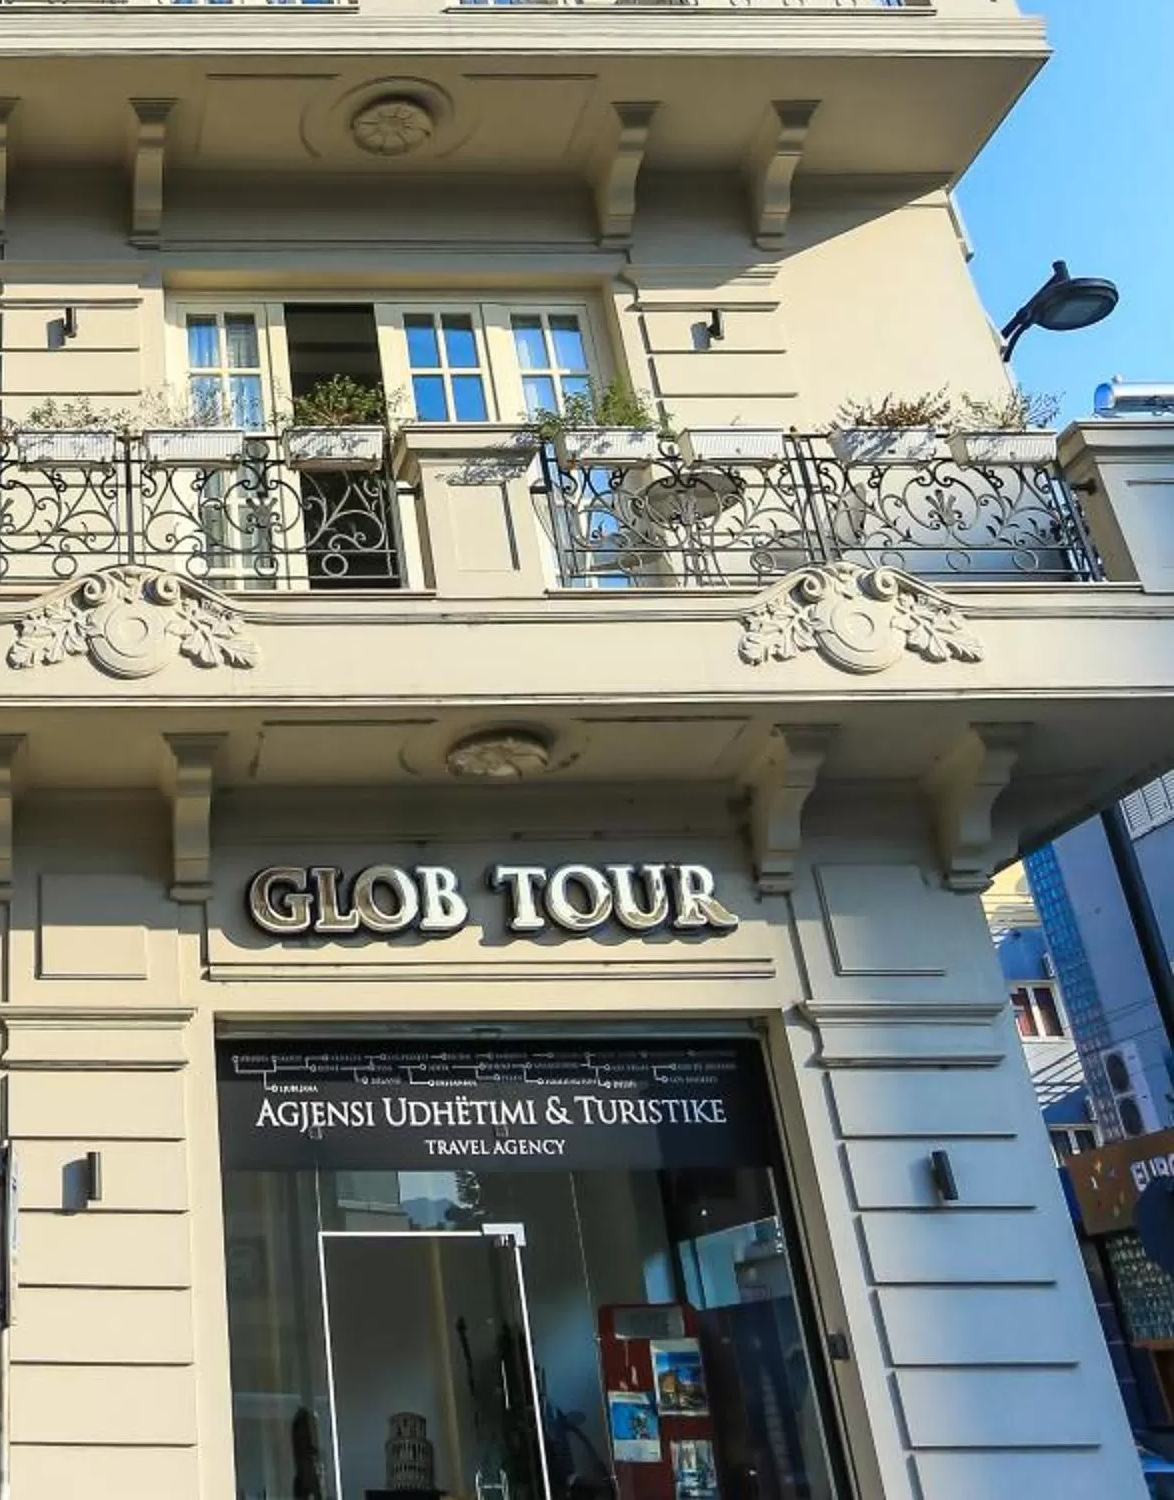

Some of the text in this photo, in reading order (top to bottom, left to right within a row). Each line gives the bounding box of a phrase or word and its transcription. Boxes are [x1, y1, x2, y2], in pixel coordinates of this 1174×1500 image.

[249, 864, 738, 933] GLOB TOUR
[255, 1095, 727, 1133] AGJENSI UDHËTIMI & TURISTIKE
[423, 1139, 566, 1156] TRAVEL AGENCY
